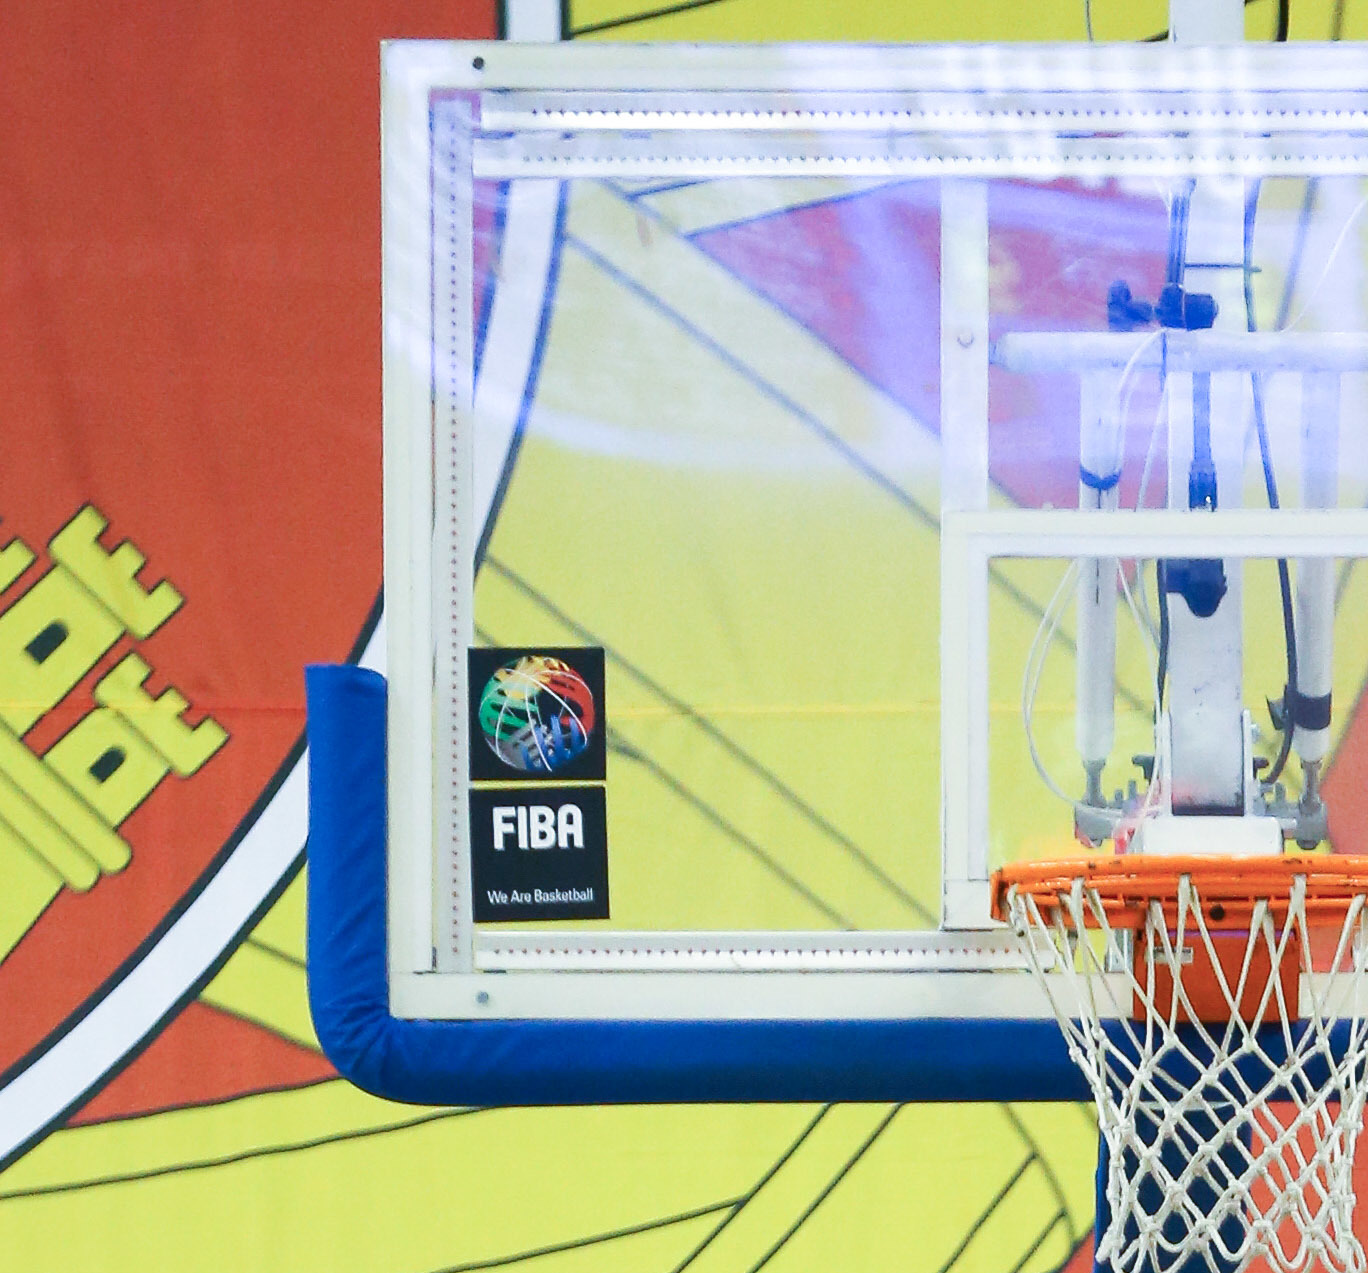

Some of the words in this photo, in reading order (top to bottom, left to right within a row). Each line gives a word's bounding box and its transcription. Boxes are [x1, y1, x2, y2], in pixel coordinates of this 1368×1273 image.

[492, 804, 585, 850] FIBA
[487, 889, 508, 904] We
[511, 889, 531, 903] Are
[534, 886, 594, 903] Basketball
